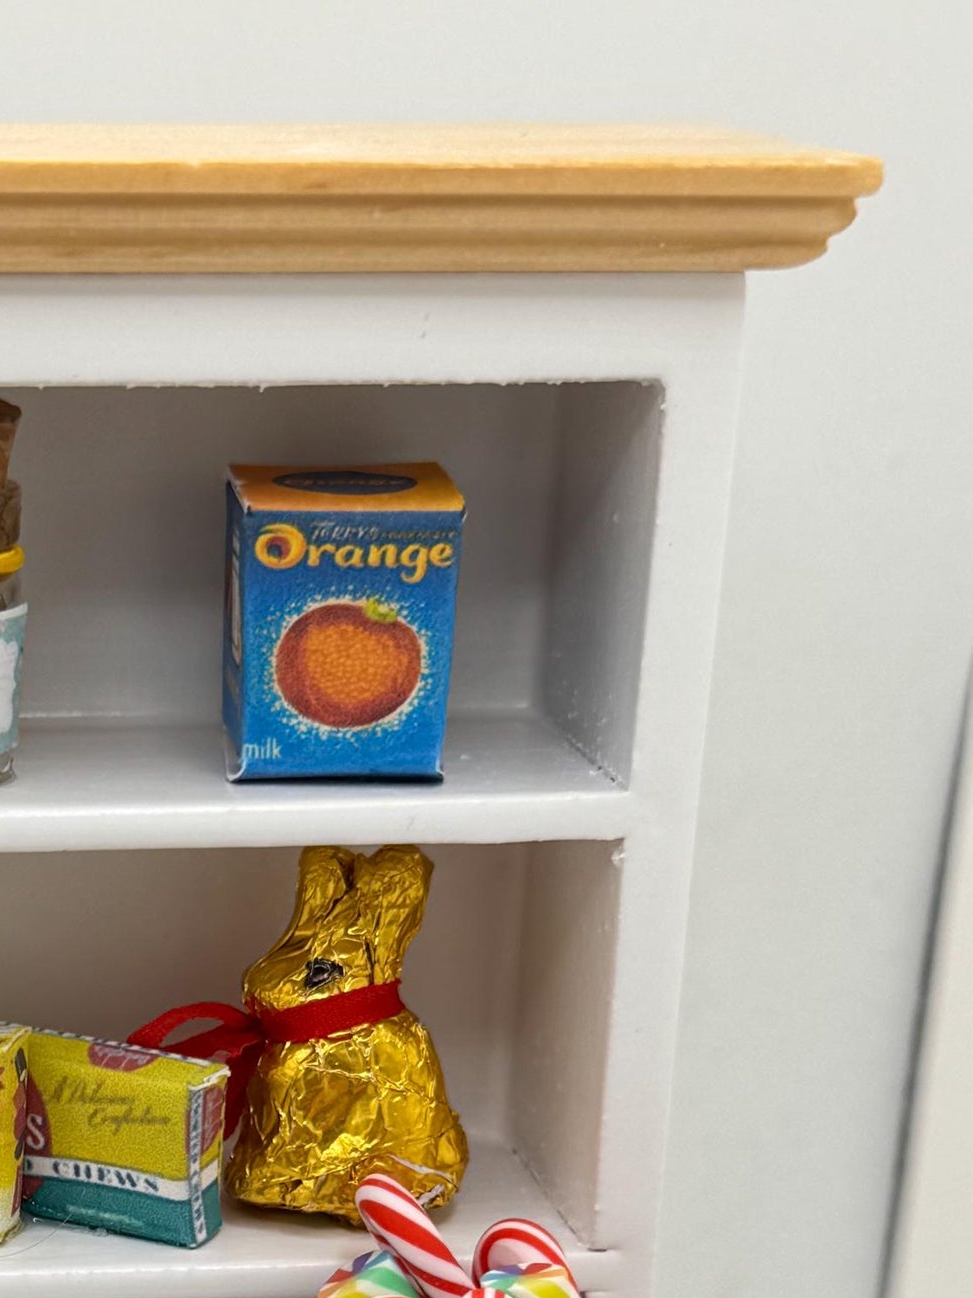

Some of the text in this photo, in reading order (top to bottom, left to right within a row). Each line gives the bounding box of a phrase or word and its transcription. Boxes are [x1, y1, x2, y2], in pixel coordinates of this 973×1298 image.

[254, 522, 454, 584] Orange
[241, 737, 283, 760] milk
[52, 1160, 160, 1192] CHEWS
